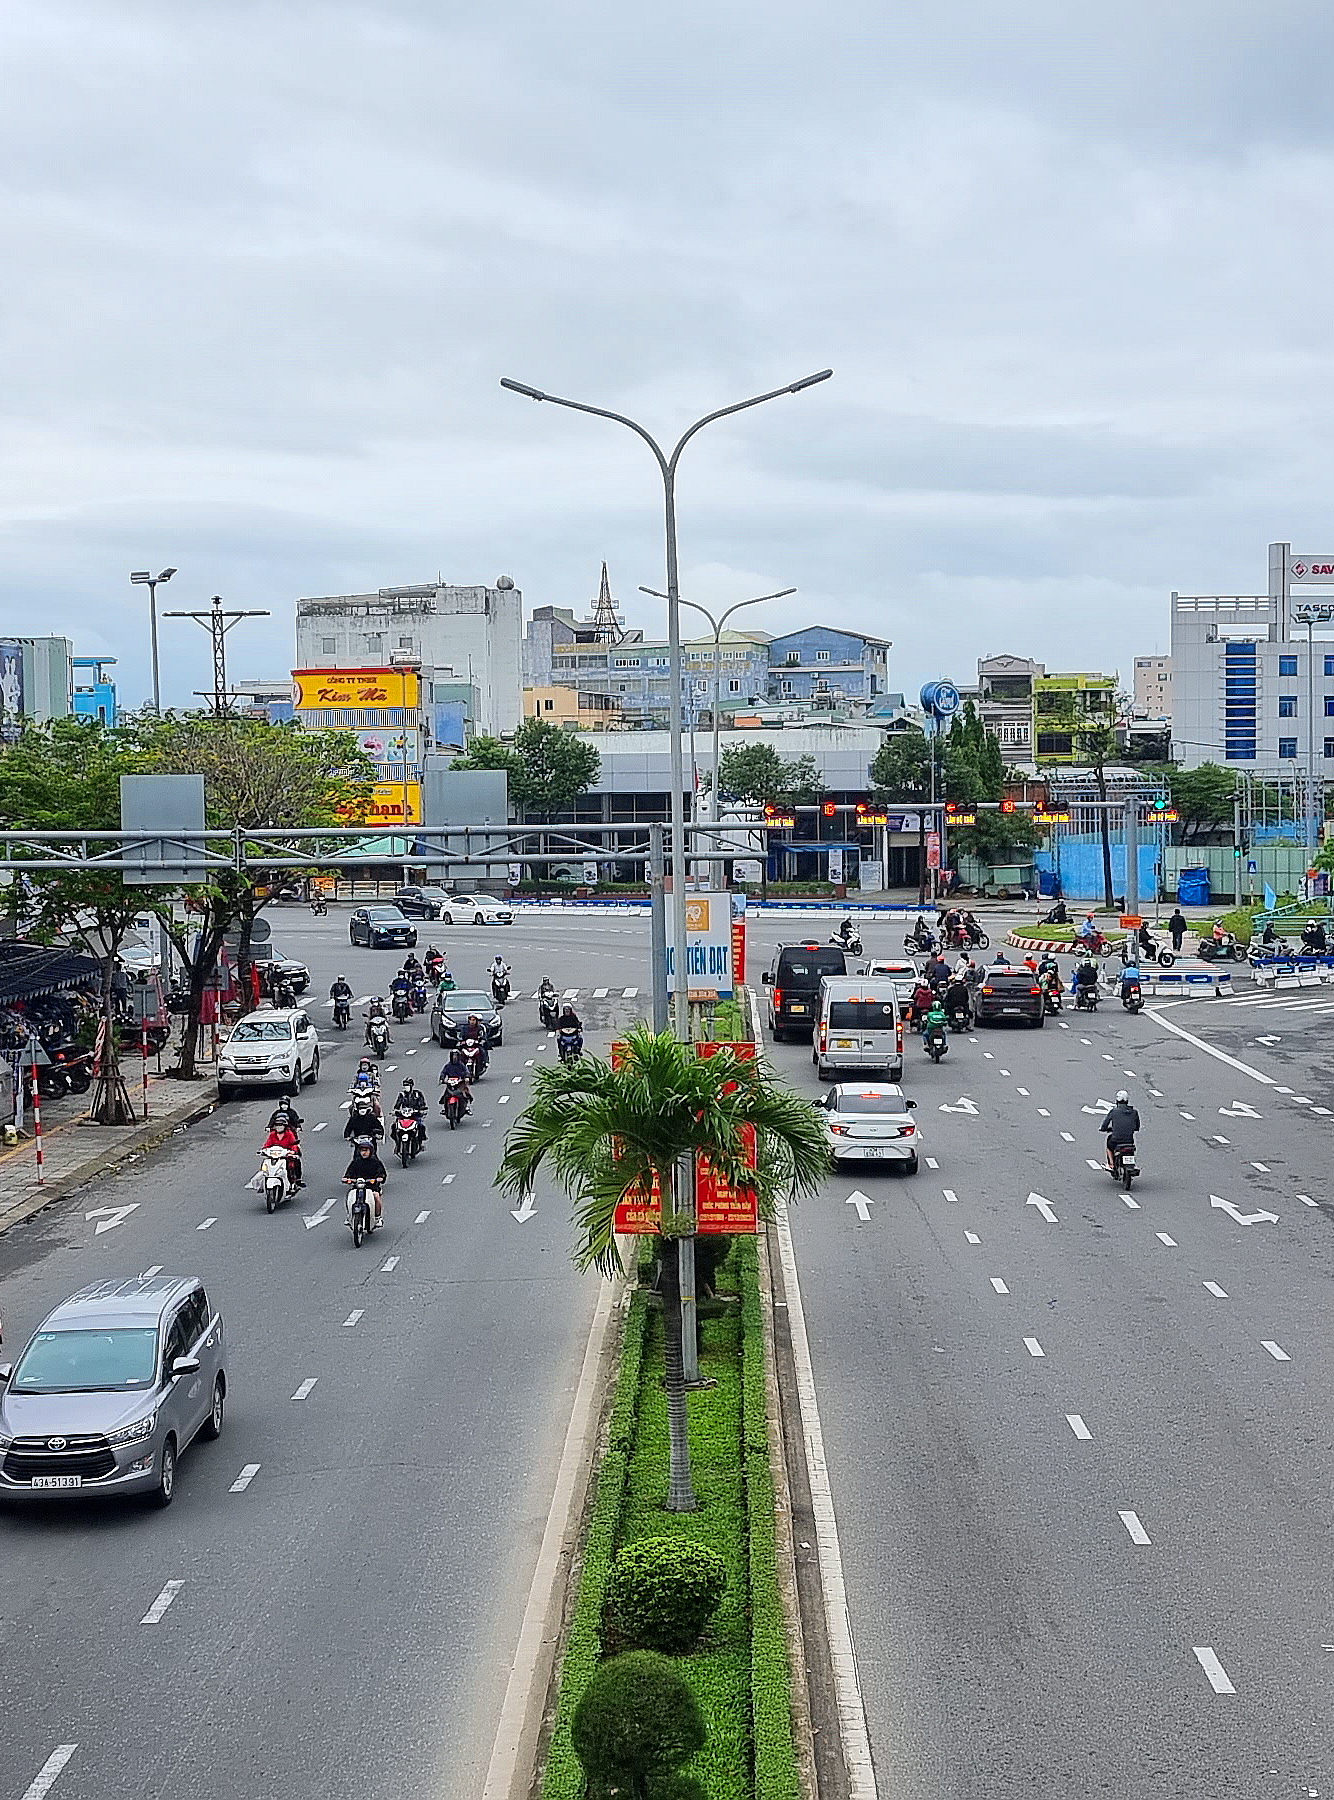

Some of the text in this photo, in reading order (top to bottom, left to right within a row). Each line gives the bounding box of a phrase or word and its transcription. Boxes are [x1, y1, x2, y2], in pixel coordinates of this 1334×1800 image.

[317, 688, 388, 702] Kim Mã
[709, 945, 729, 981] ĐẠT
